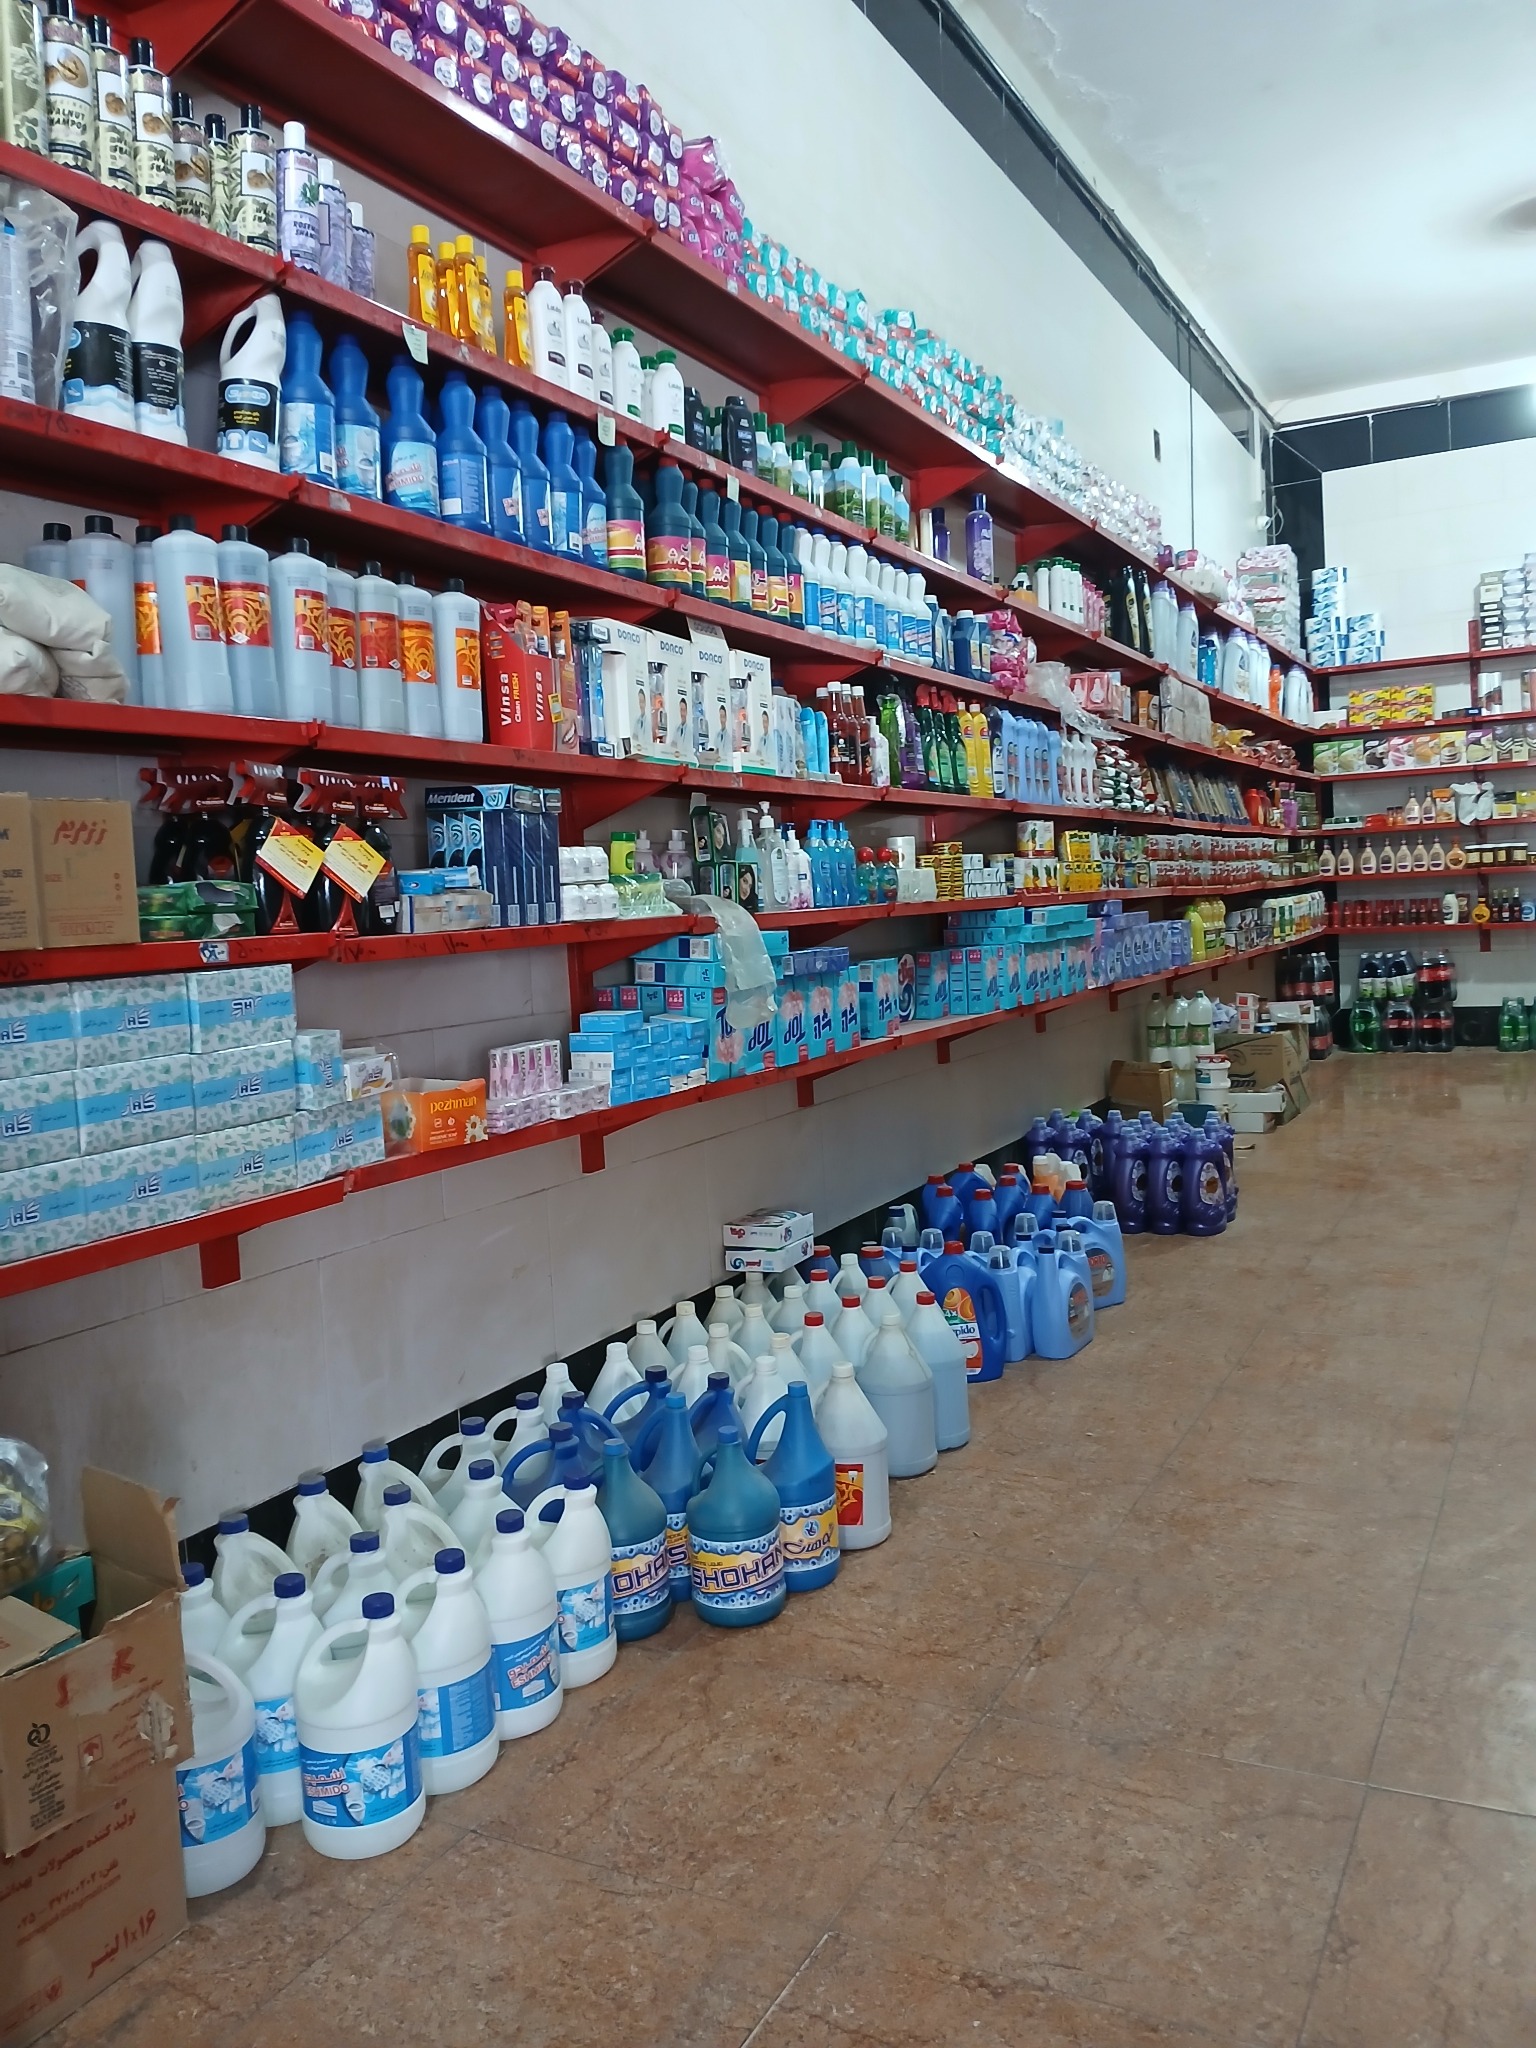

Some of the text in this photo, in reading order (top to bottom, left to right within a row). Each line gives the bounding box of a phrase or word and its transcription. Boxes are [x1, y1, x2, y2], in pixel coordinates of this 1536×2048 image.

[512, 672, 520, 700] FRESH
[535, 671, 545, 722] Vinsa
[500, 673, 512, 726] Vinsa
[426, 792, 476, 805] Merident
[2, 868, 24, 879] SIZE
[117, 1007, 152, 1032] گلنار
[715, 1006, 737, 1041] TO
[783, 1012, 806, 1045] TOP
[230, 1075, 263, 1100] گلنار
[121, 1091, 156, 1117] گلنار
[430, 1095, 477, 1115] pezhman
[331, 1127, 355, 1152] گلنار
[233, 1152, 266, 1178] گلنار
[126, 1174, 162, 1201] گلنار
[952, 1325, 976, 1339] pido
[613, 1553, 668, 1595] OHA
[692, 1542, 784, 1588] SHOHAN
[510, 1654, 552, 1689] ESHMIDO
[113, 1808, 137, 1832] تولید
[86, 1825, 111, 1849] کننده
